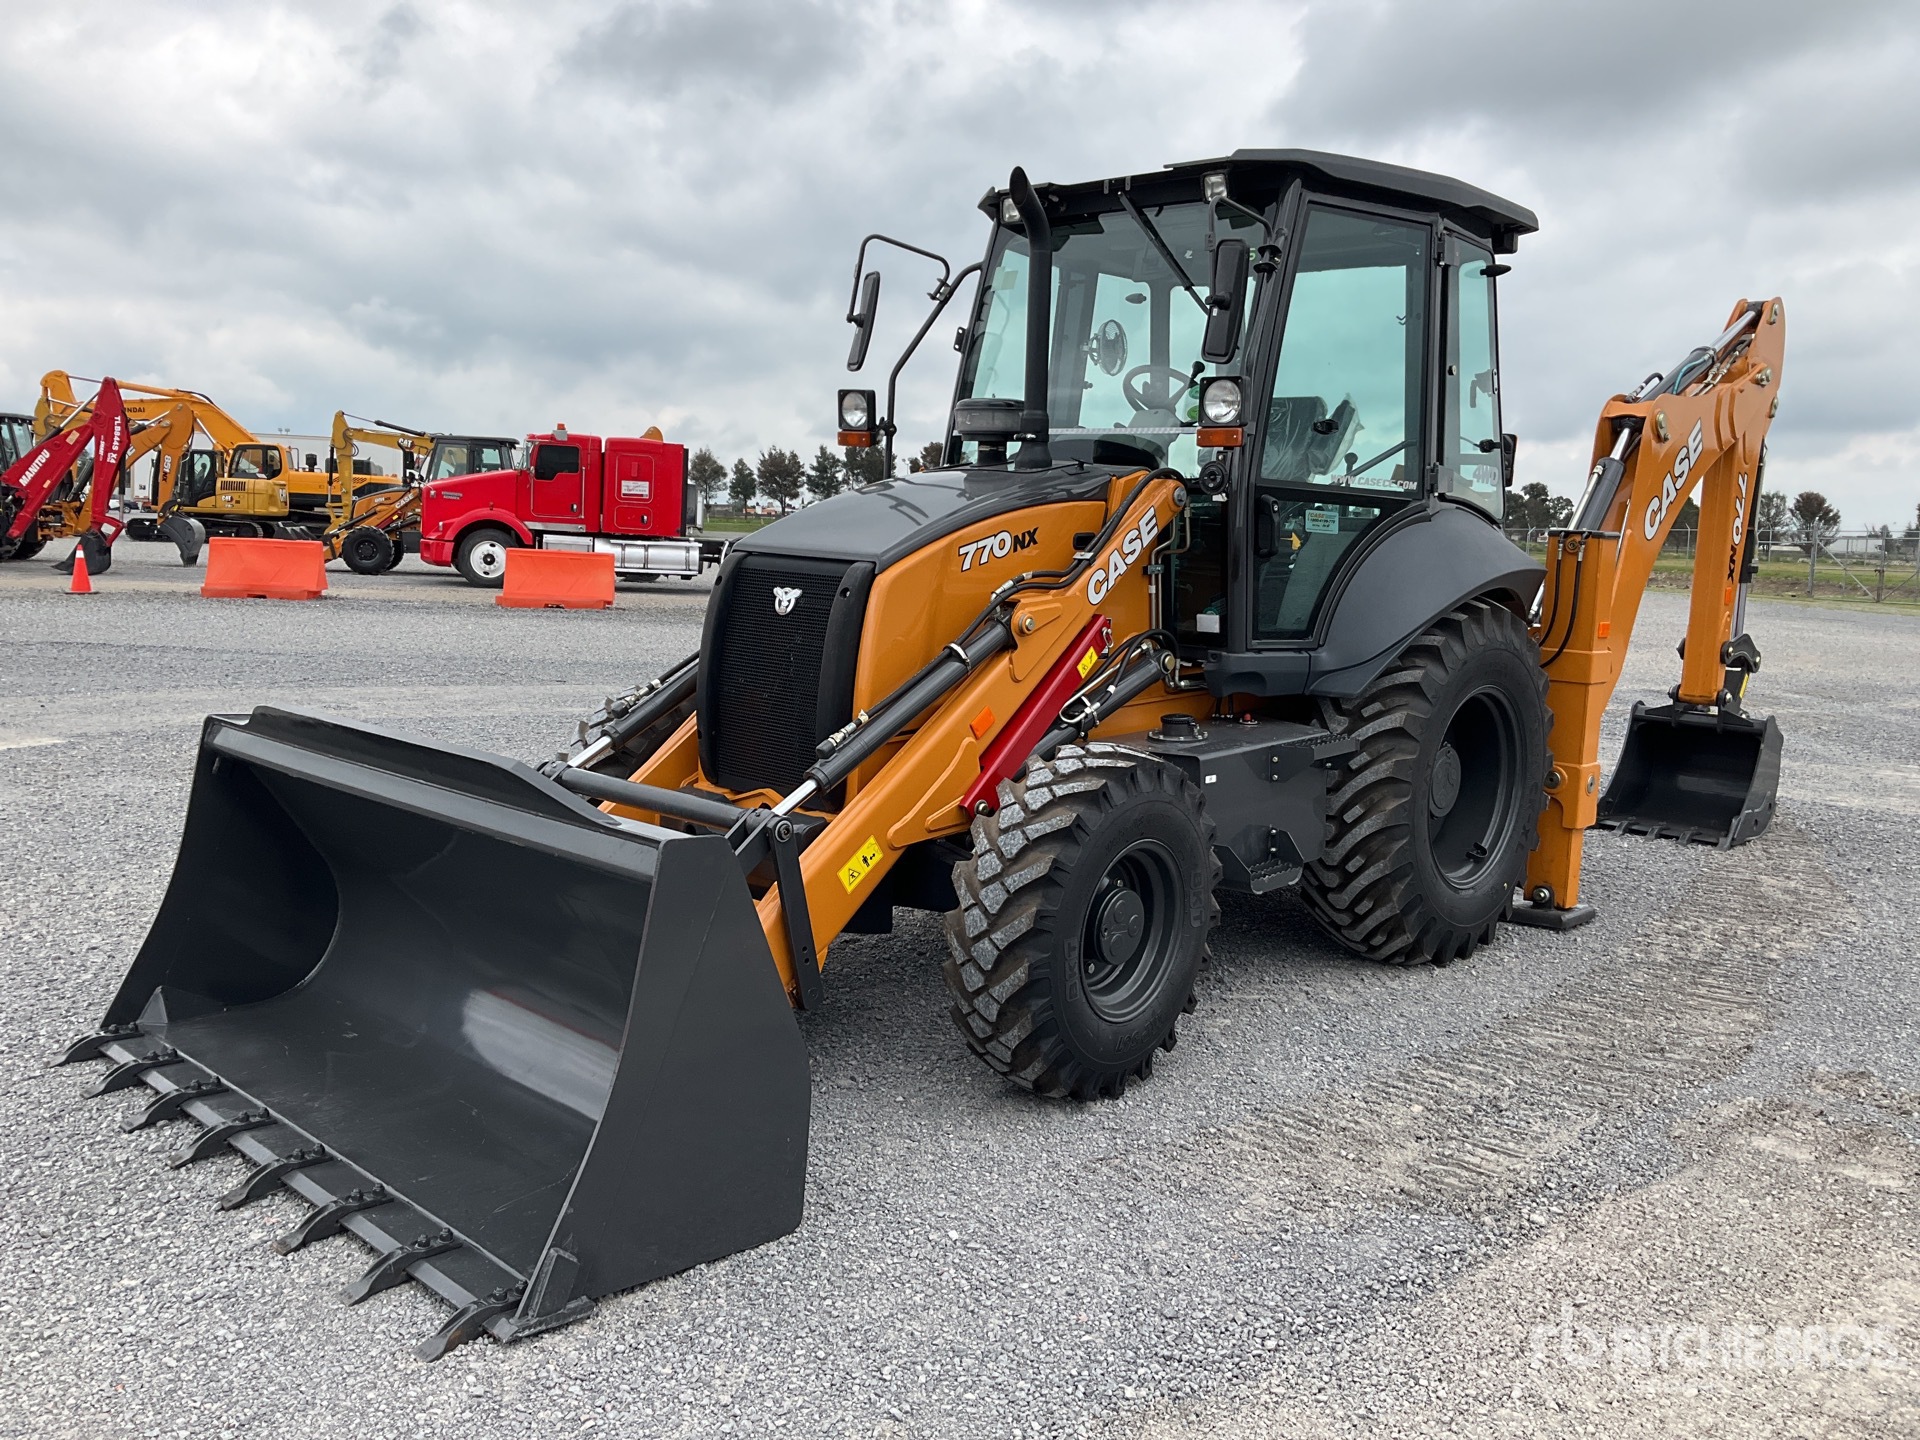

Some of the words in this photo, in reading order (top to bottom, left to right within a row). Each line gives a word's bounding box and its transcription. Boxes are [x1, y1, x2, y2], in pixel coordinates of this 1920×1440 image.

[398, 437, 413, 448] CAT
[19, 449, 51, 487] MANITOU
[1472, 464, 1499, 487] 4WD
[1643, 416, 1704, 541] CASE
[395, 493, 414, 509] CASE
[1087, 505, 1159, 605] CASE
[1190, 871, 1207, 928] BKT
